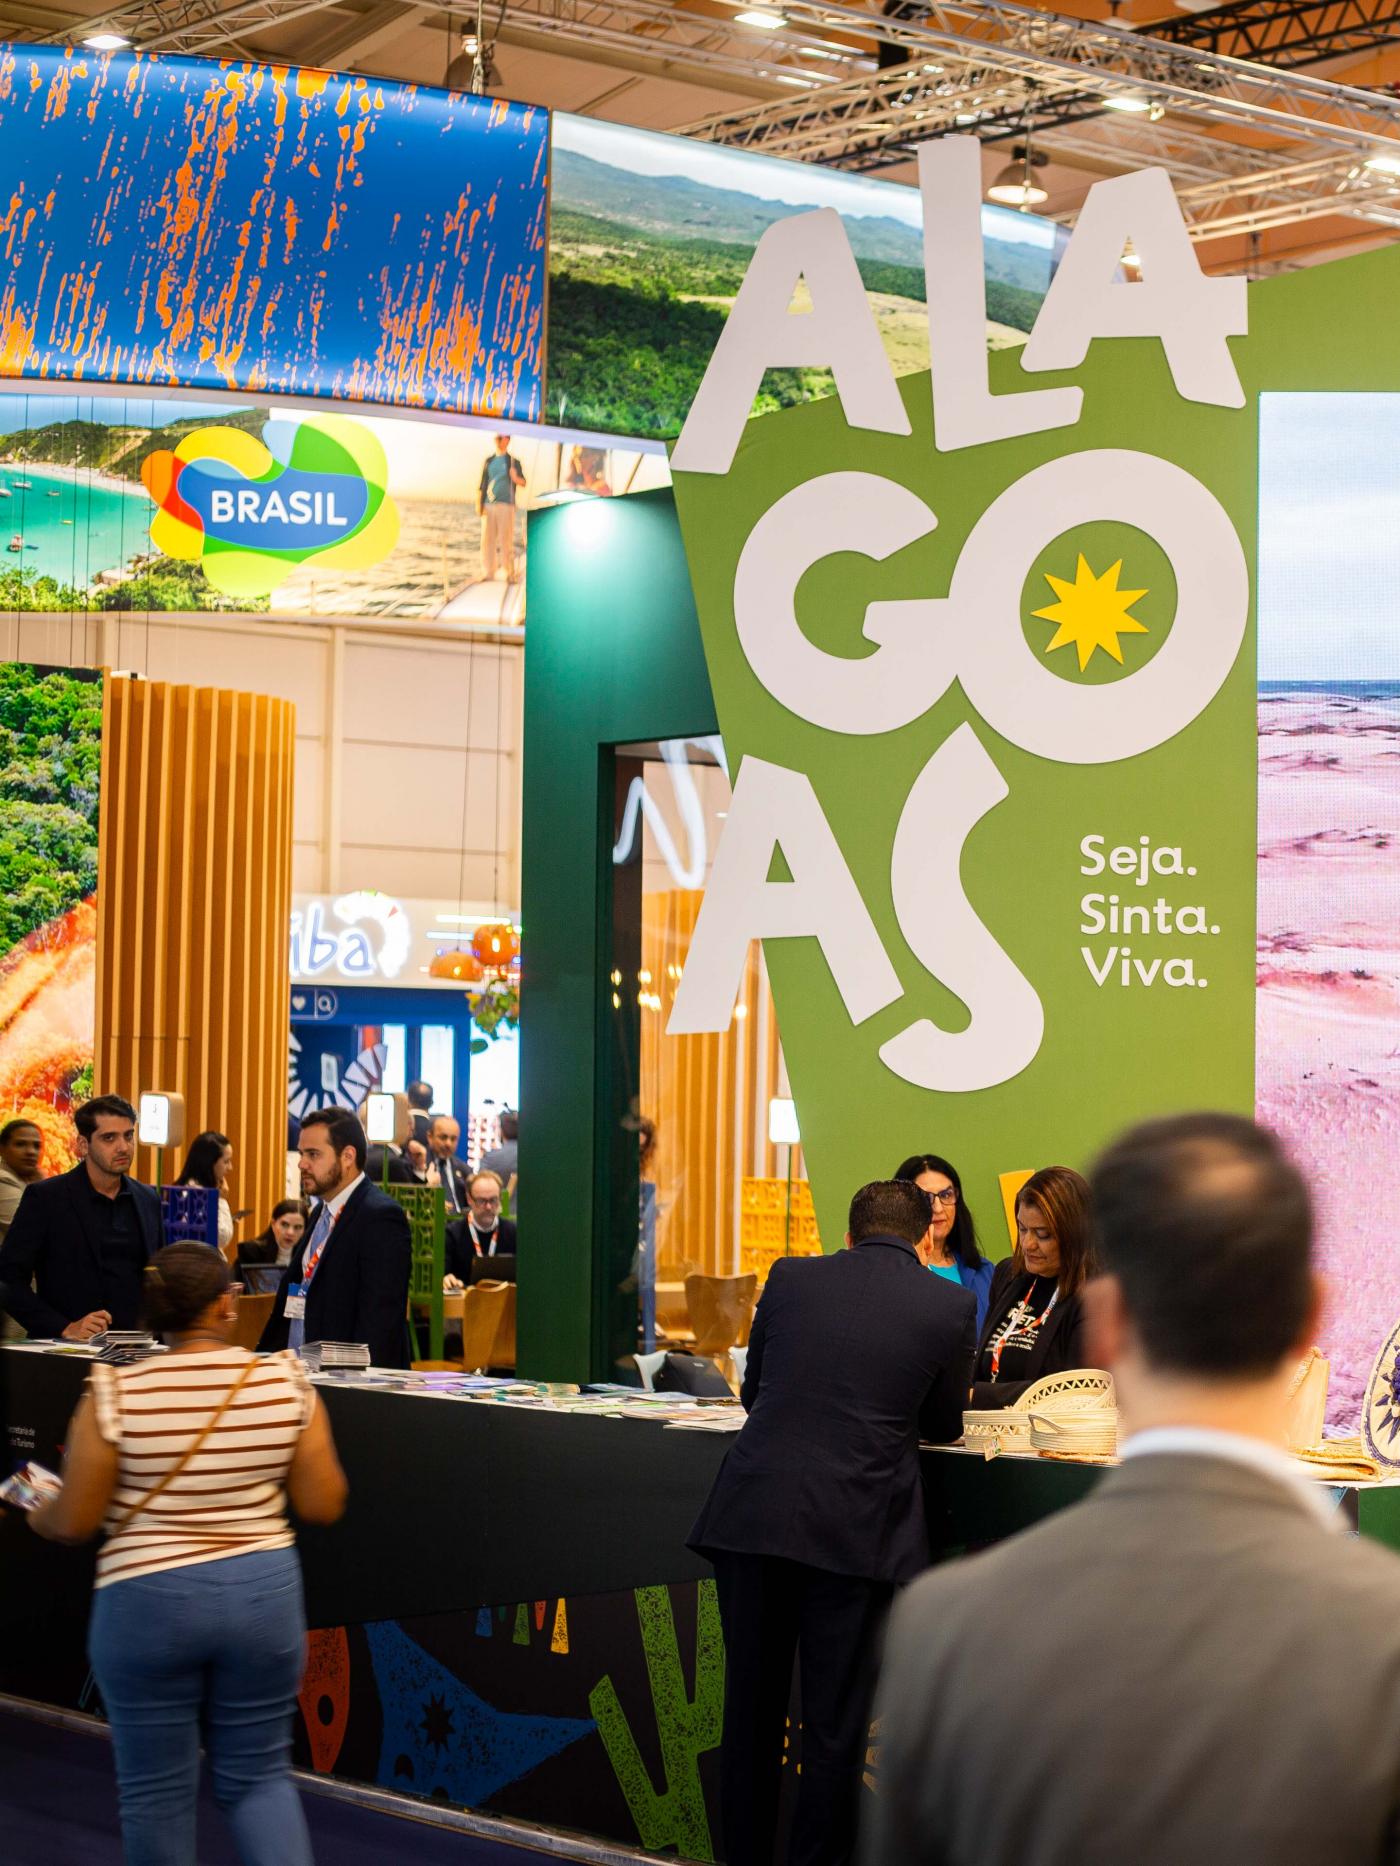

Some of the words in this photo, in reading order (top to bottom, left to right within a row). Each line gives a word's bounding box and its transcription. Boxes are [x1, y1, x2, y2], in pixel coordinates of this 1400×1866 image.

[669, 135, 1248, 475] ALA
[211, 490, 348, 526] BRASIL
[733, 448, 1250, 765] GO
[1080, 834, 1198, 886] Seja.
[665, 721, 1045, 1093] AS
[1080, 894, 1221, 935] Sinta.
[1081, 947, 1208, 988] Viva.
